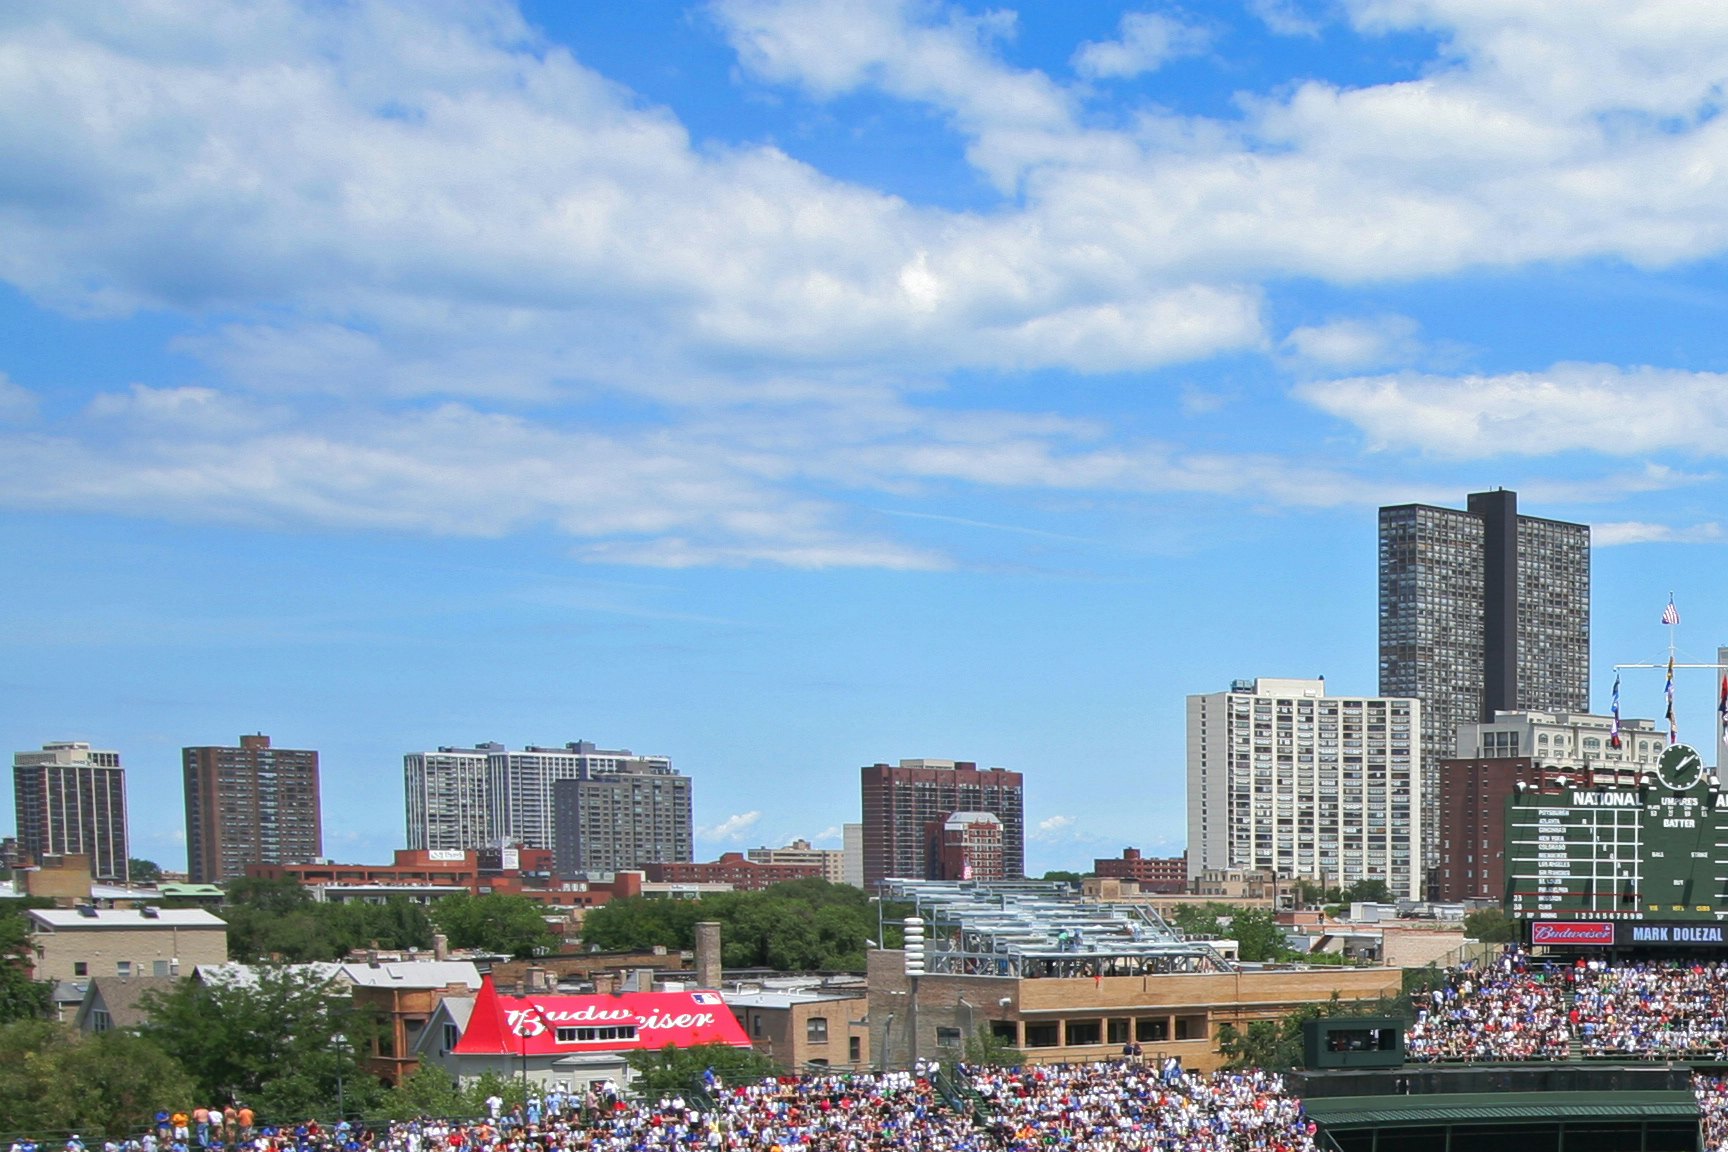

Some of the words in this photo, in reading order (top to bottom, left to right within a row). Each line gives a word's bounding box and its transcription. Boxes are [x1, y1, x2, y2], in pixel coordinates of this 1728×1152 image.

[1573, 792, 1643, 805] NATIONAL
[1663, 819, 1695, 828] BATTER
[1535, 925, 1610, 940] Budweiser
[1633, 927, 1668, 940] MARK
[1674, 927, 1723, 941] DOLEZAL
[504, 1005, 715, 1037] Budweiser
